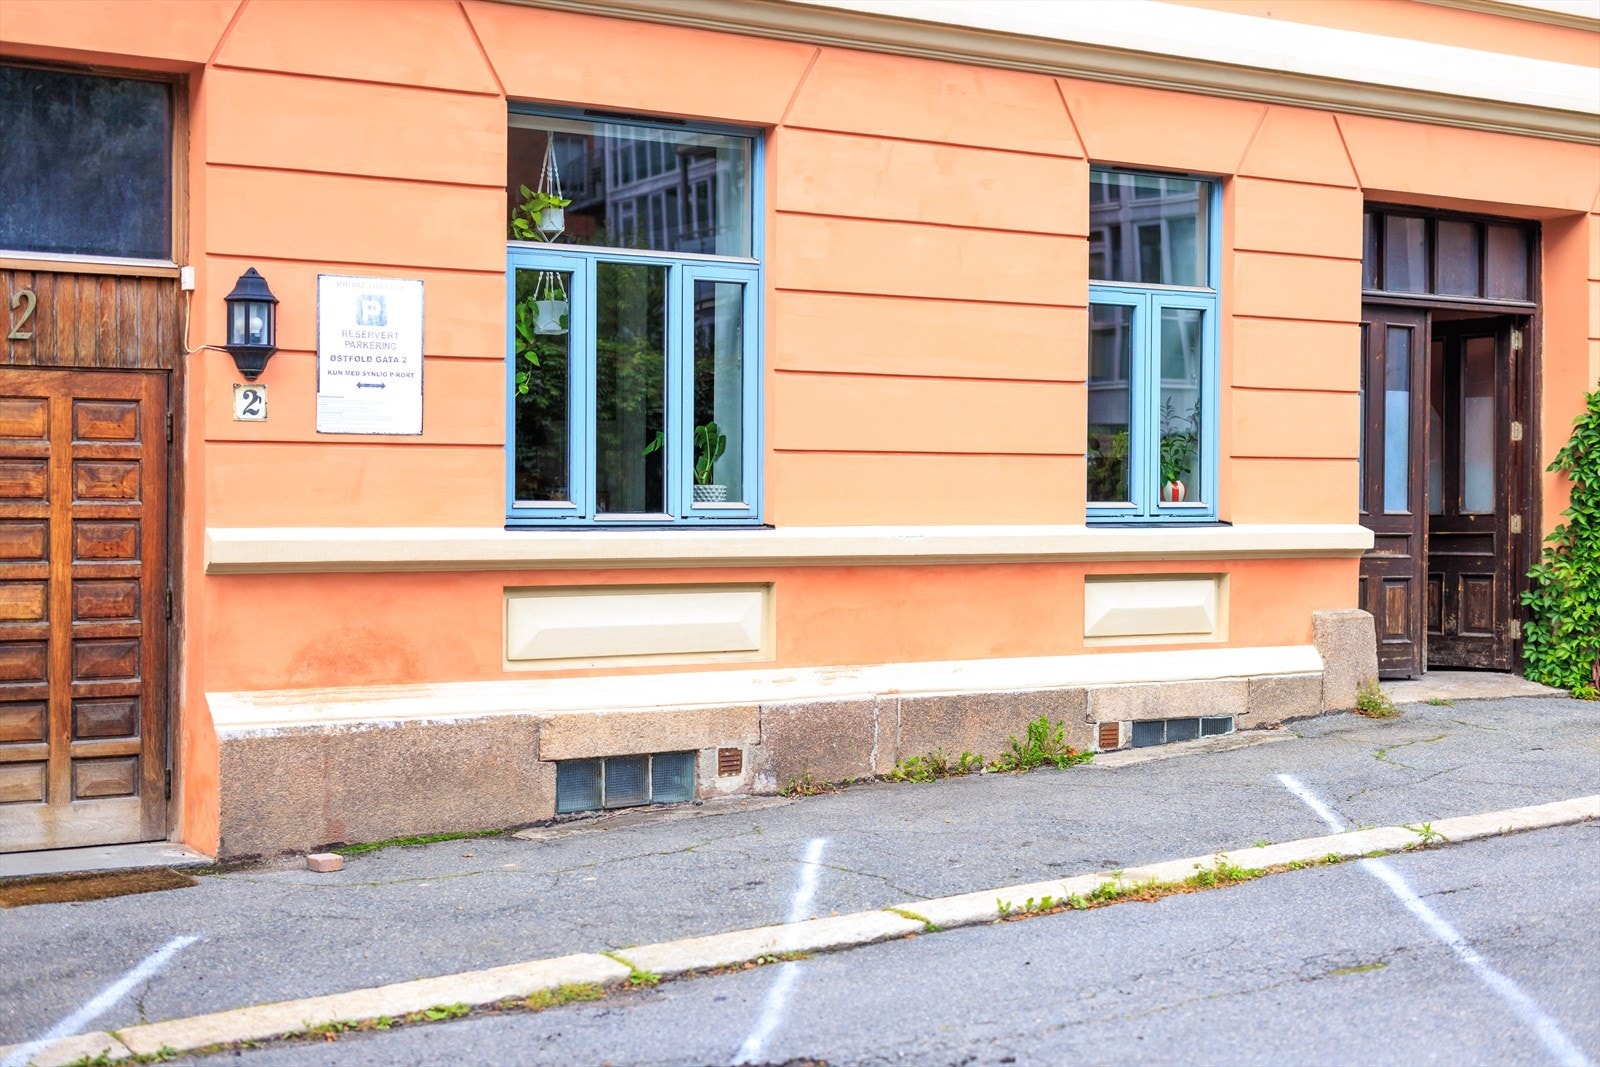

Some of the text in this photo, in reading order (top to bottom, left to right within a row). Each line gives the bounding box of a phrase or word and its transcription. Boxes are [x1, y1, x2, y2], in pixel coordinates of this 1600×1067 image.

[336, 280, 365, 289] PRIVAT
[7, 290, 36, 339] 2
[362, 299, 382, 326] P
[341, 329, 399, 339] RESERVERT
[344, 340, 397, 350] PARKERING
[330, 354, 373, 363] ØSTFOLD
[402, 356, 408, 364] 2
[242, 389, 261, 416] 2
